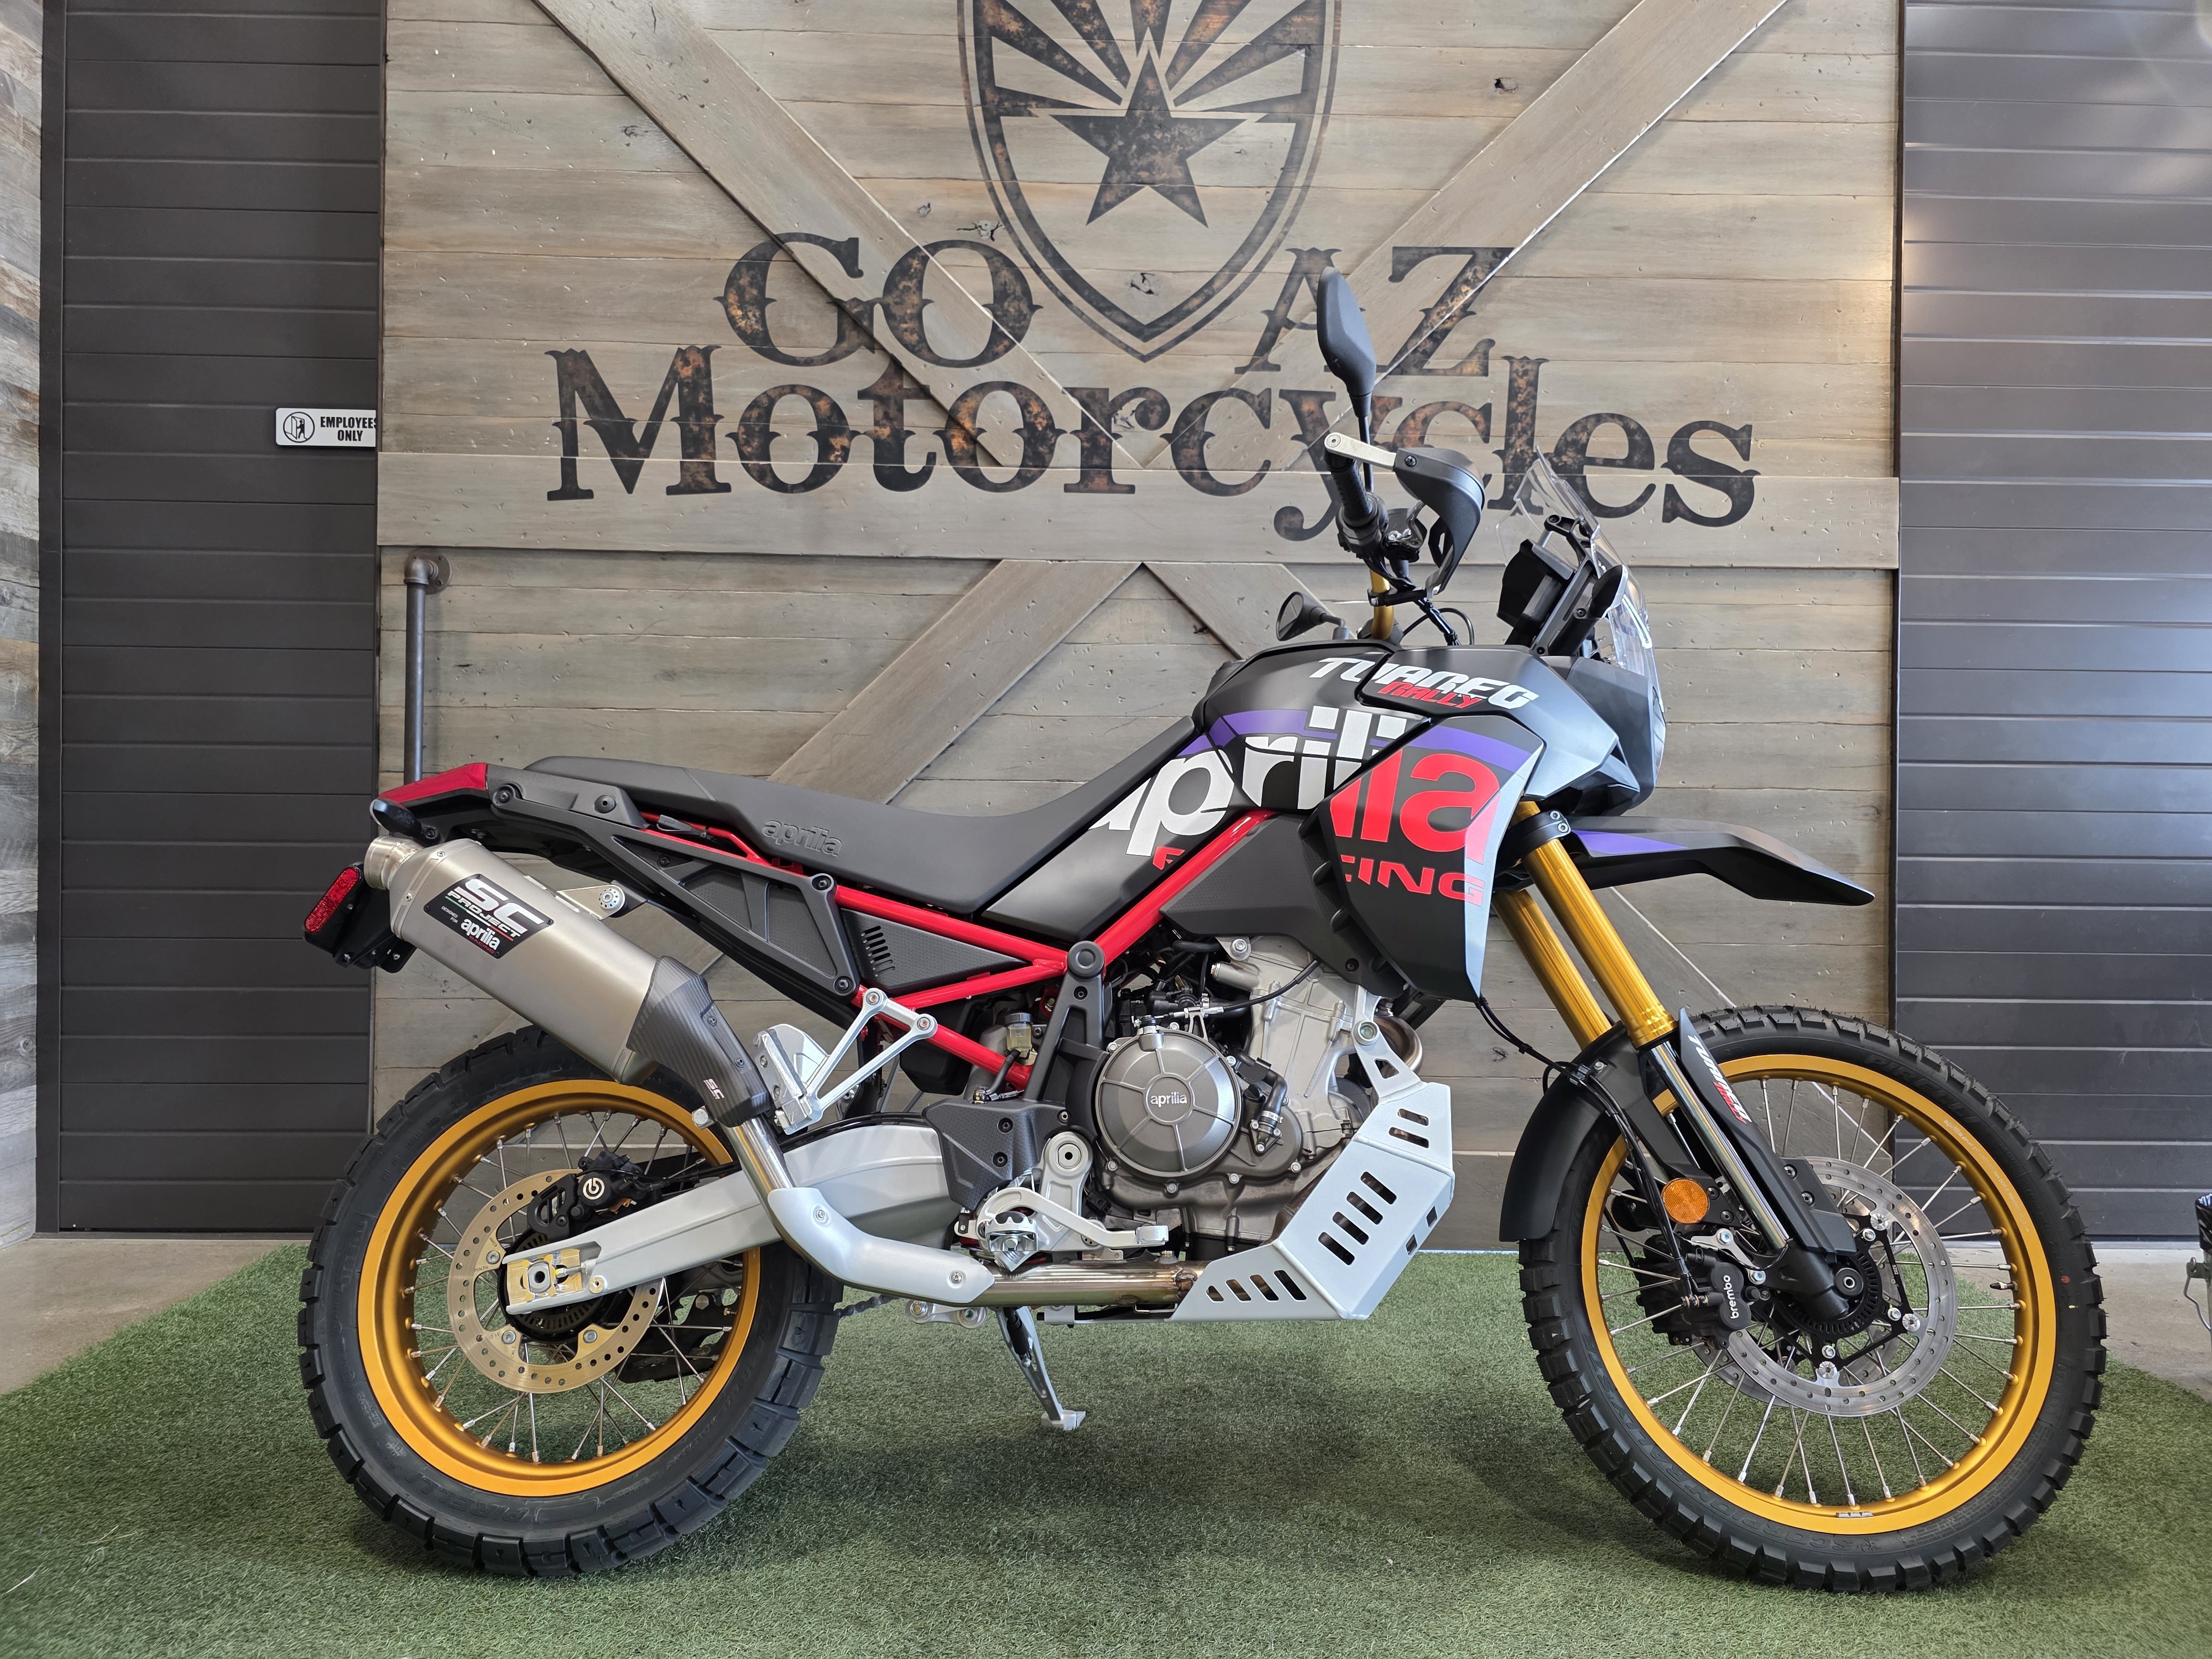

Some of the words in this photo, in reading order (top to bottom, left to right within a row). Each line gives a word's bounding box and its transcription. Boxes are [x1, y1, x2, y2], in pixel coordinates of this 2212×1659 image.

[712, 232, 1043, 368] GO
[1234, 247, 1515, 377] AZ
[337, 430, 363, 441] ONLY
[545, 345, 1760, 541] Motorcycles
[1308, 656, 1540, 710] TUAREG
[1377, 681, 1485, 709] RALLY
[1088, 705, 1501, 865] prilia
[761, 820, 842, 857] aprilia
[441, 906, 458, 918] DESIGNED
[447, 890, 521, 938] PROJECT
[453, 879, 545, 935] SC
[460, 918, 500, 951] aprilia
[468, 935, 495, 954] RACING
[1150, 1091, 1187, 1108] aprilia
[1723, 1275, 1739, 1319] brembo
[405, 1471, 530, 1522] PIRELLI
